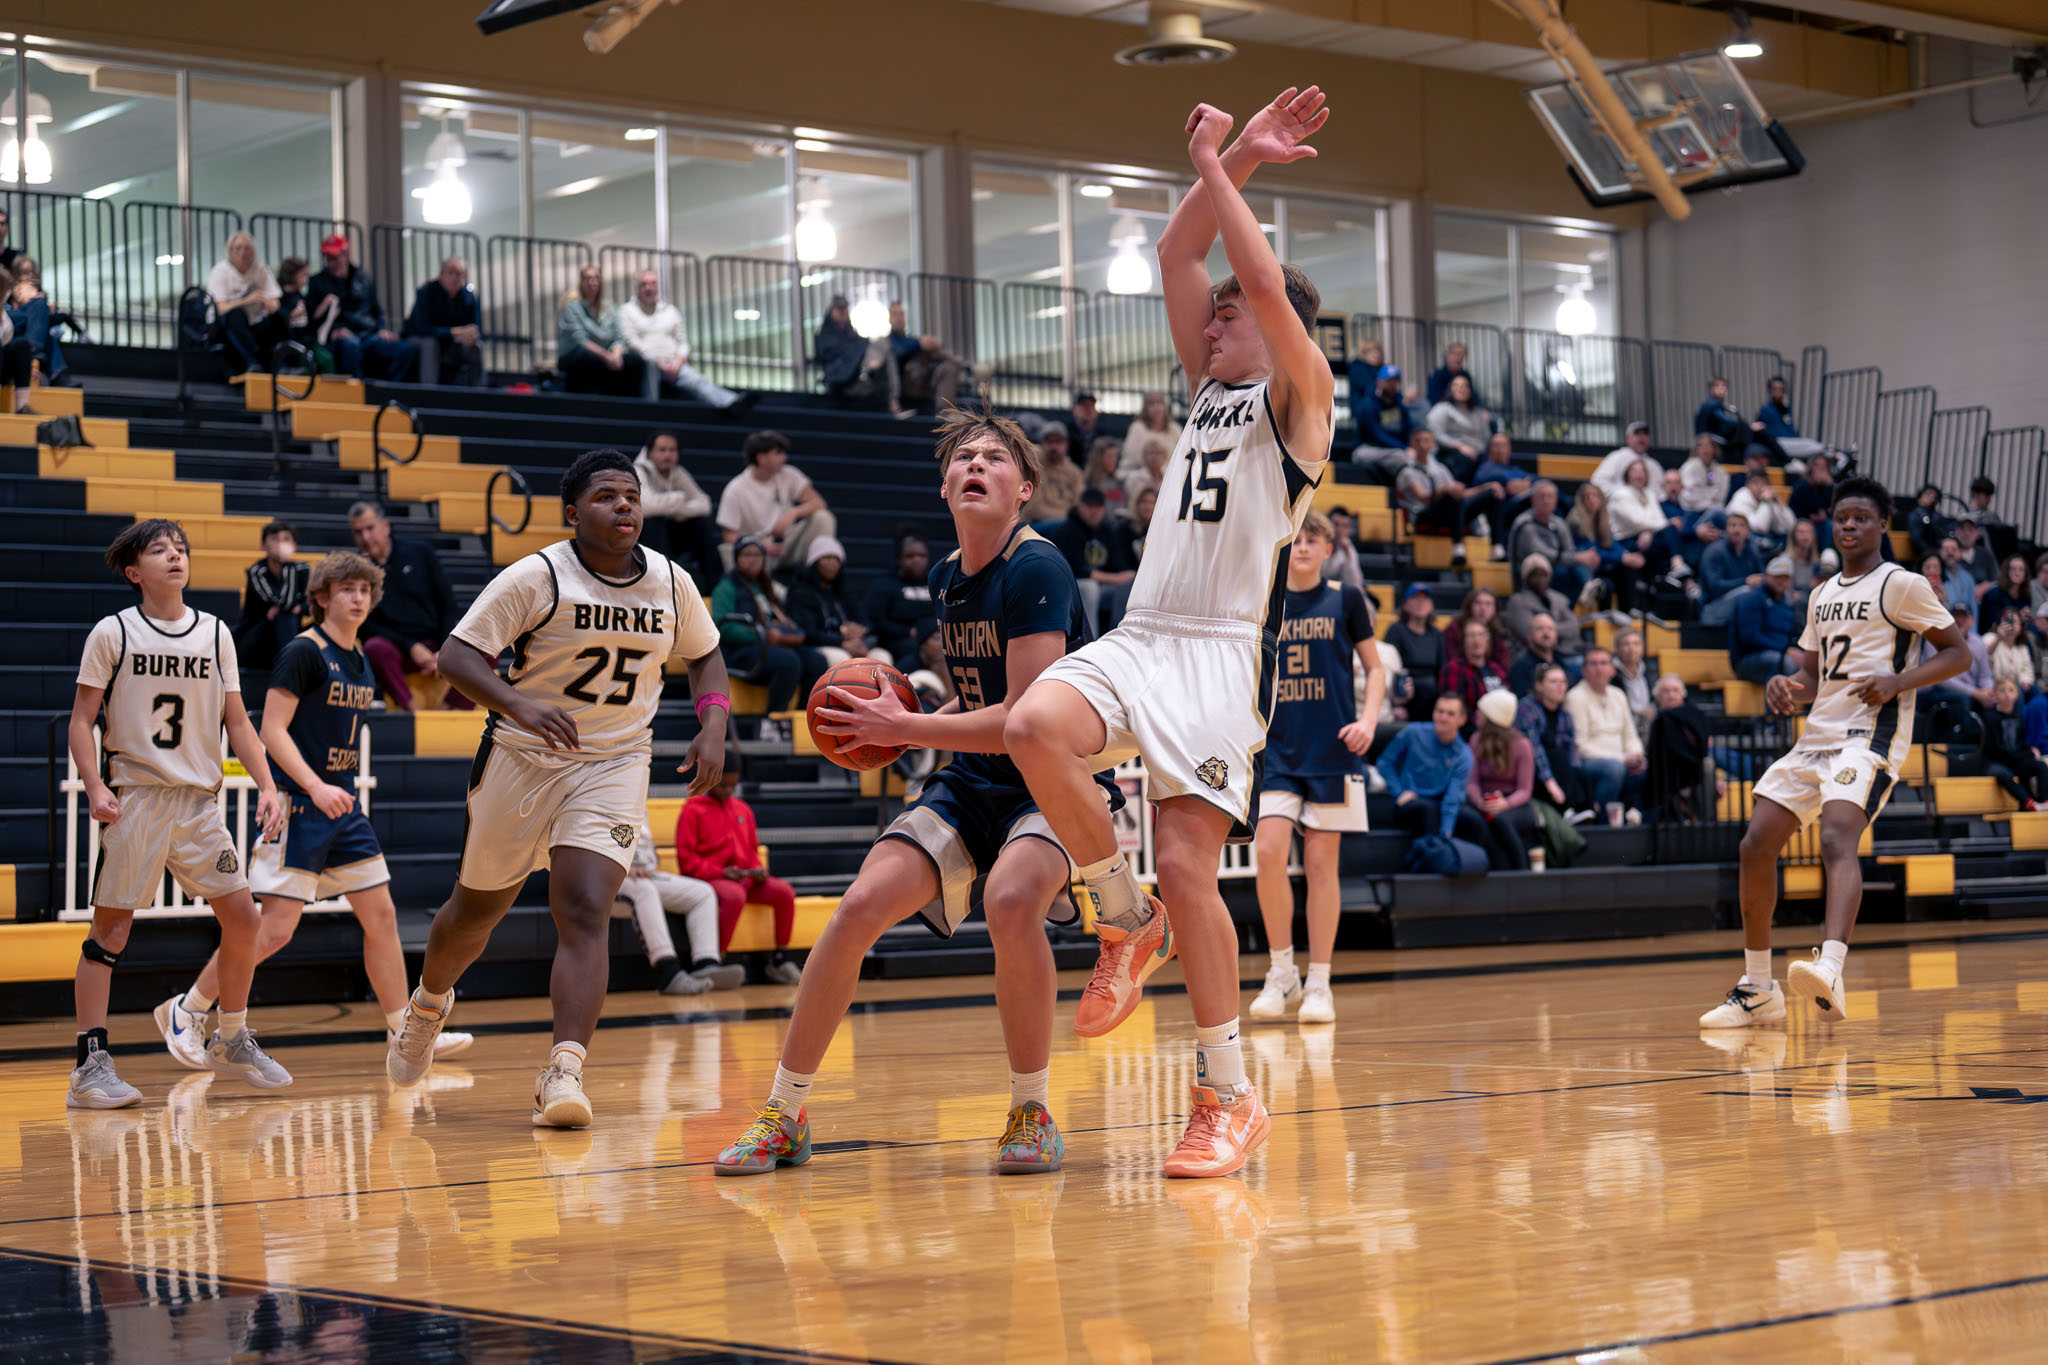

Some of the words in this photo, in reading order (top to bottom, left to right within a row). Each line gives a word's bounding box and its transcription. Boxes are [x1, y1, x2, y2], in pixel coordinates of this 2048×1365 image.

[1176, 446, 1238, 524] 15
[573, 604, 664, 634] BURKE
[1815, 601, 1871, 624] BURKE
[937, 618, 1001, 657] LKHORN
[1281, 617, 1335, 641] KHORN
[132, 653, 212, 680] BURKE
[1287, 644, 1310, 675] 21
[1820, 633, 1852, 681] 12
[562, 646, 654, 706] 25
[952, 666, 986, 711] 23
[1278, 677, 1325, 703] SOUTH
[326, 680, 374, 711] ELKHOR
[151, 692, 185, 750] 3
[348, 712, 358, 746] 1
